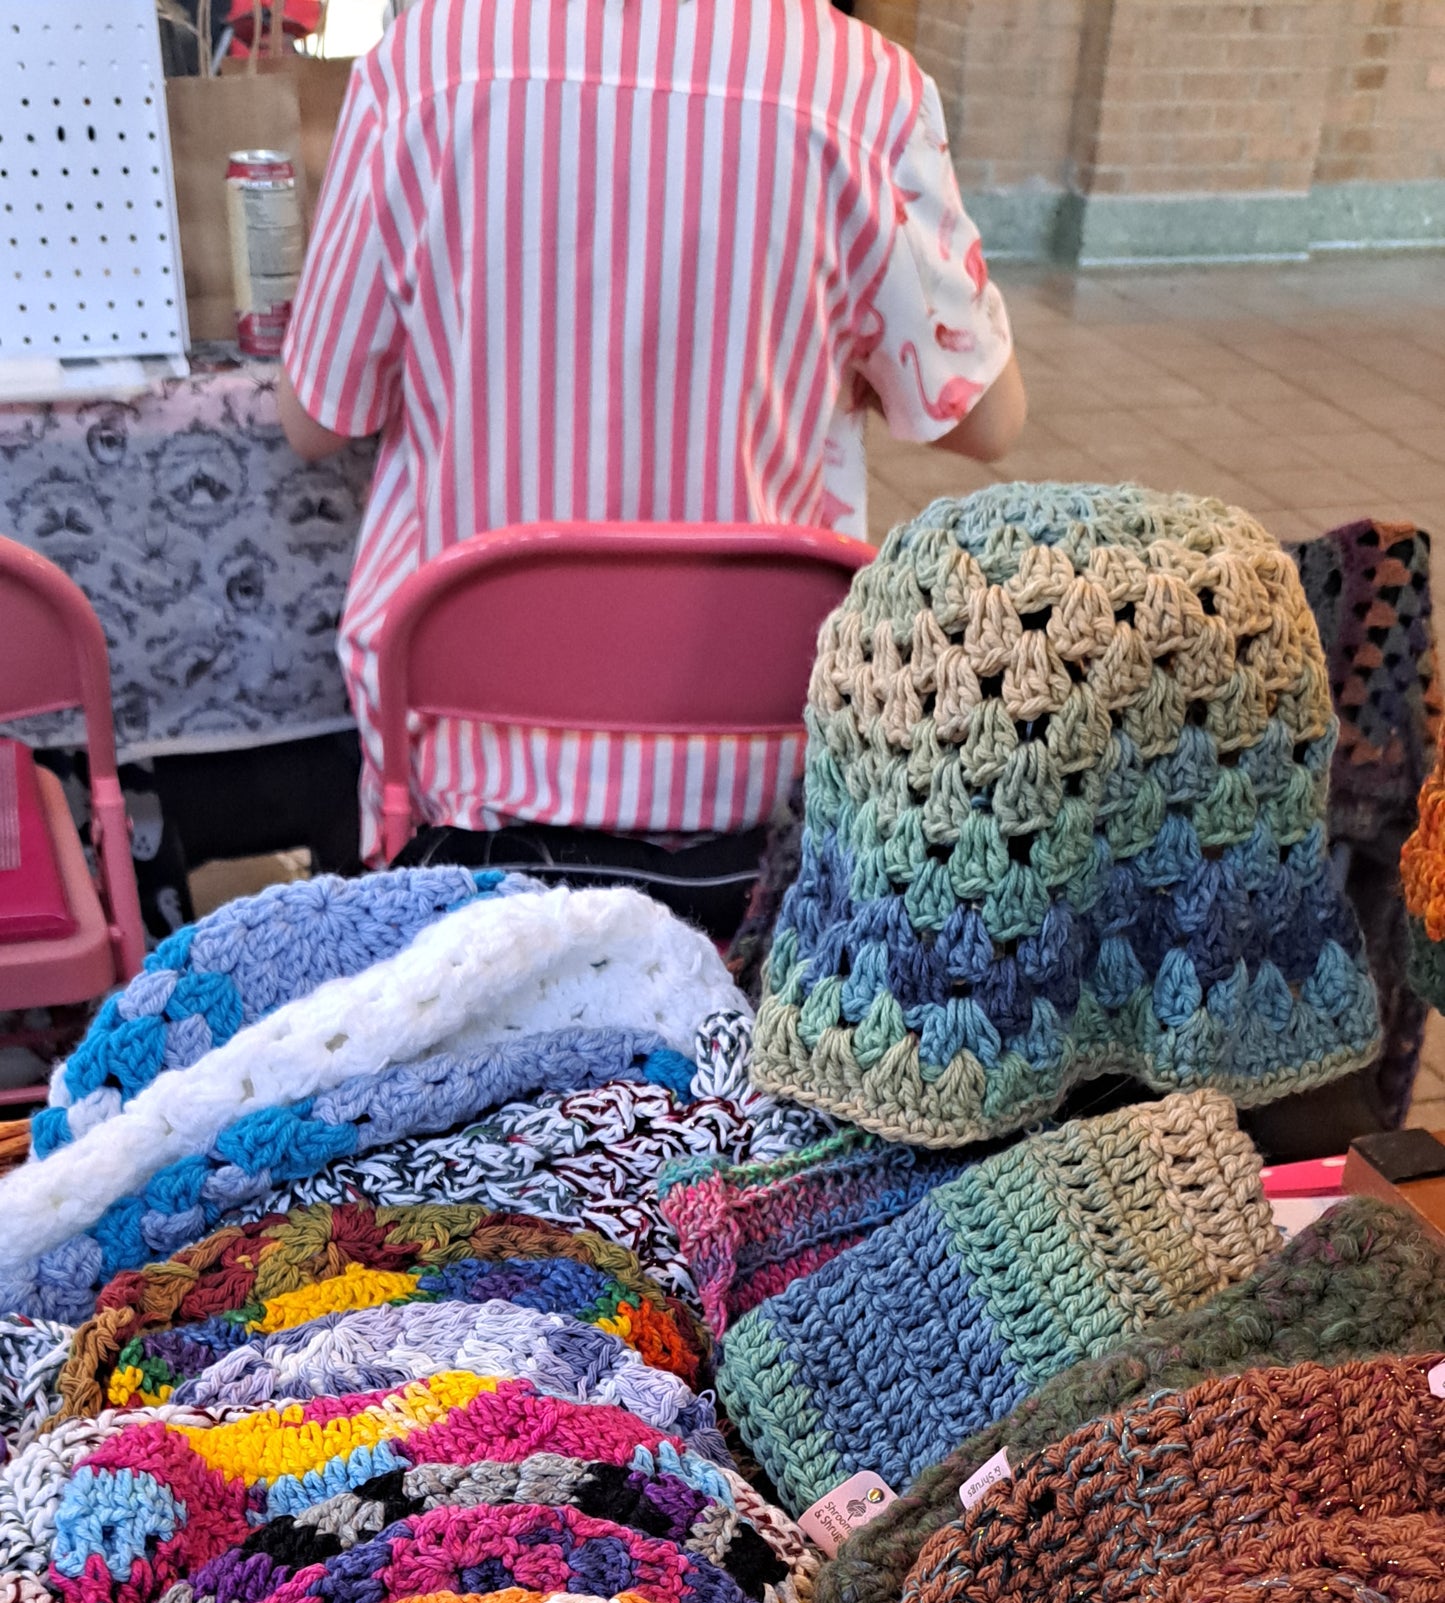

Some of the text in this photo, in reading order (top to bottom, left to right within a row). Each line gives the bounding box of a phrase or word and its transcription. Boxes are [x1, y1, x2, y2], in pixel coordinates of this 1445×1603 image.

[967, 1465, 1002, 1498] & Shrugs
[814, 1508, 825, 1519] &
